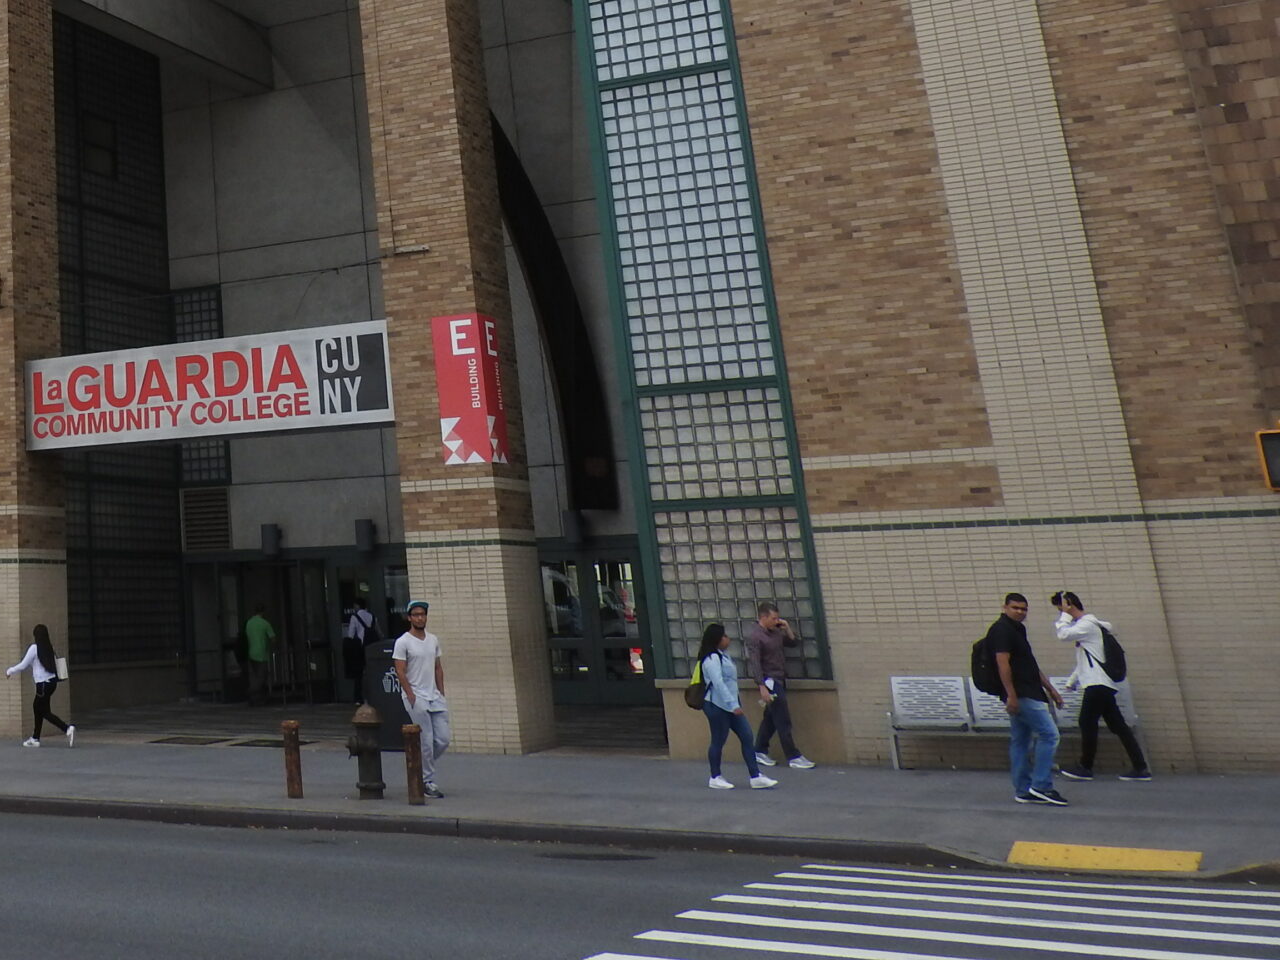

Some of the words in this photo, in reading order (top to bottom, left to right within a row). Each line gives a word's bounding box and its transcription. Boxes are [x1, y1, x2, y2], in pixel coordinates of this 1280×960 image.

[320, 335, 361, 374] CU
[450, 319, 476, 356] E
[485, 321, 498, 357] E
[32, 344, 308, 415] LaGUARDIA
[320, 376, 362, 415] NY
[468, 358, 481, 409] BUILDING
[494, 361, 504, 410] BUILDING
[32, 403, 183, 440] COMMUNITY
[190, 392, 312, 426] COLLEGE
